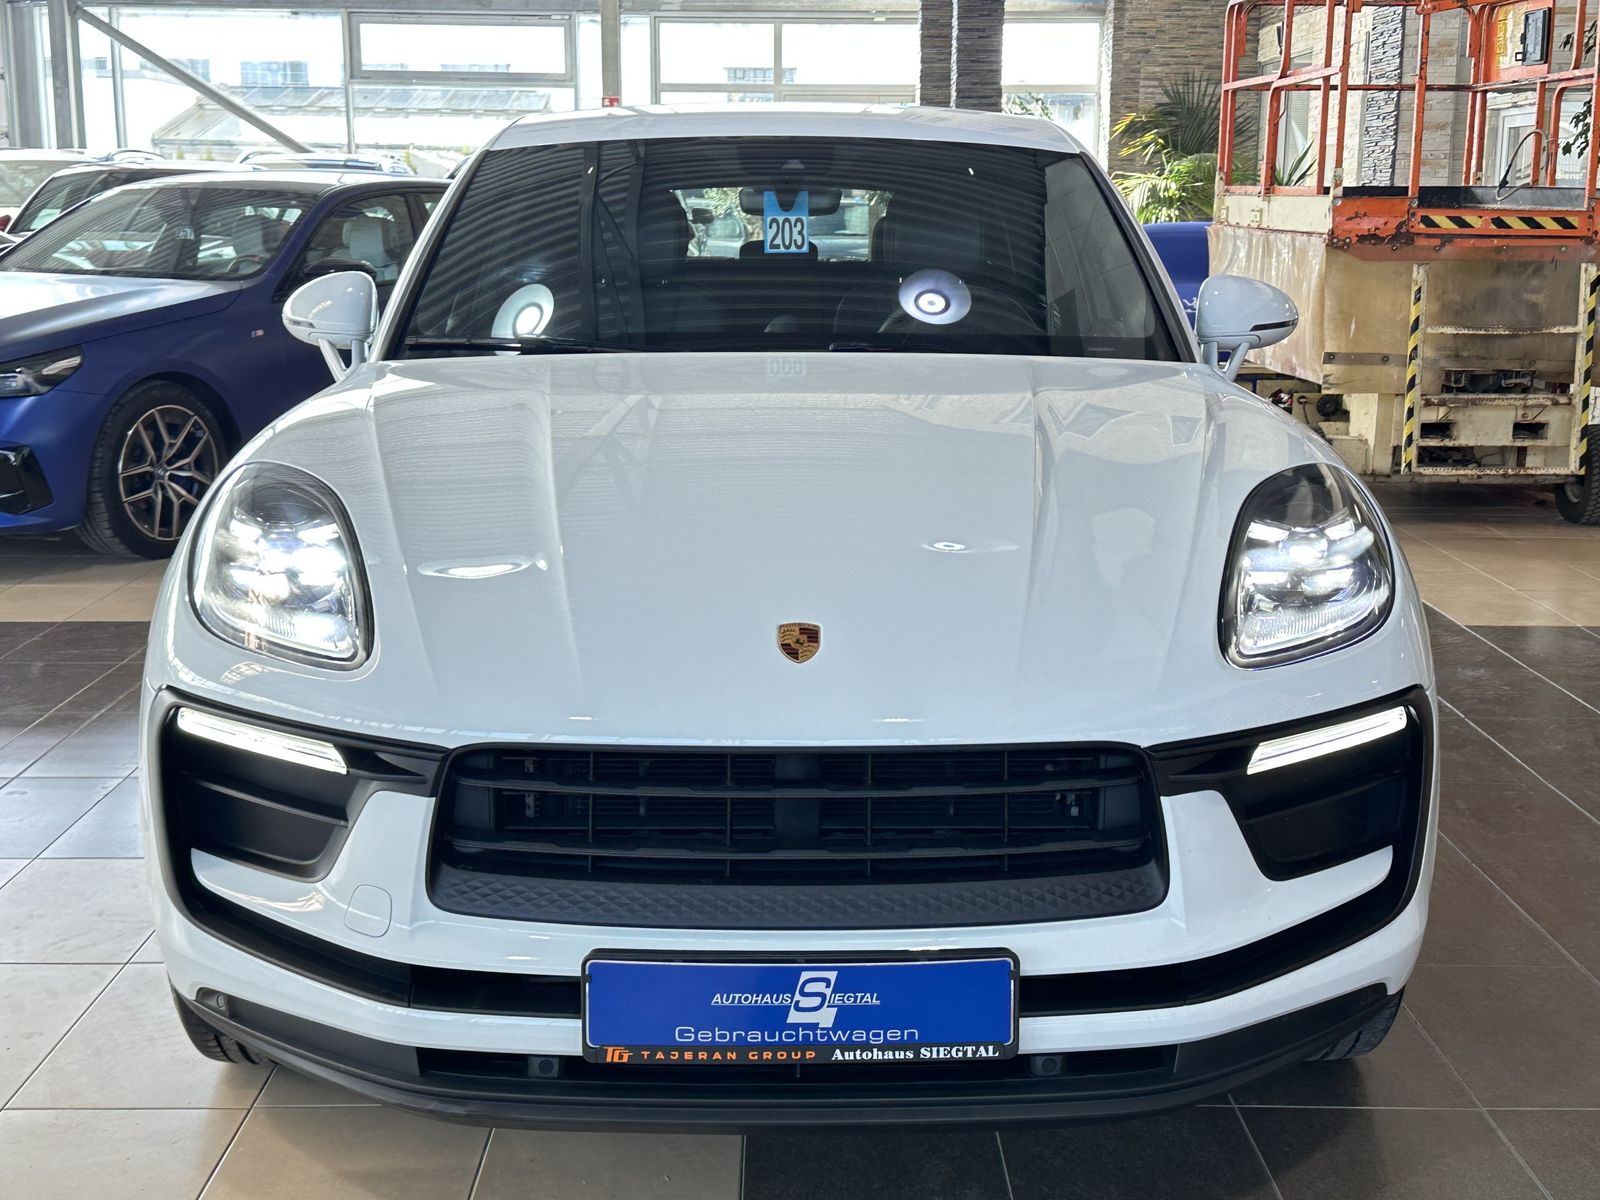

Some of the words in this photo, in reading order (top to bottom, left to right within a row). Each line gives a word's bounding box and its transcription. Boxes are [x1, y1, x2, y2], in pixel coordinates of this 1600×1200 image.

[768, 217, 806, 250] 203
[711, 993, 792, 1005] AUTOHAUS
[675, 1026, 919, 1044] Gebrauchtwagen
[641, 1051, 737, 1060] TAJERAN
[748, 1051, 816, 1060] GROUP
[831, 1048, 914, 1060] Autohaus
[919, 1045, 999, 1058] SIEGTAL
